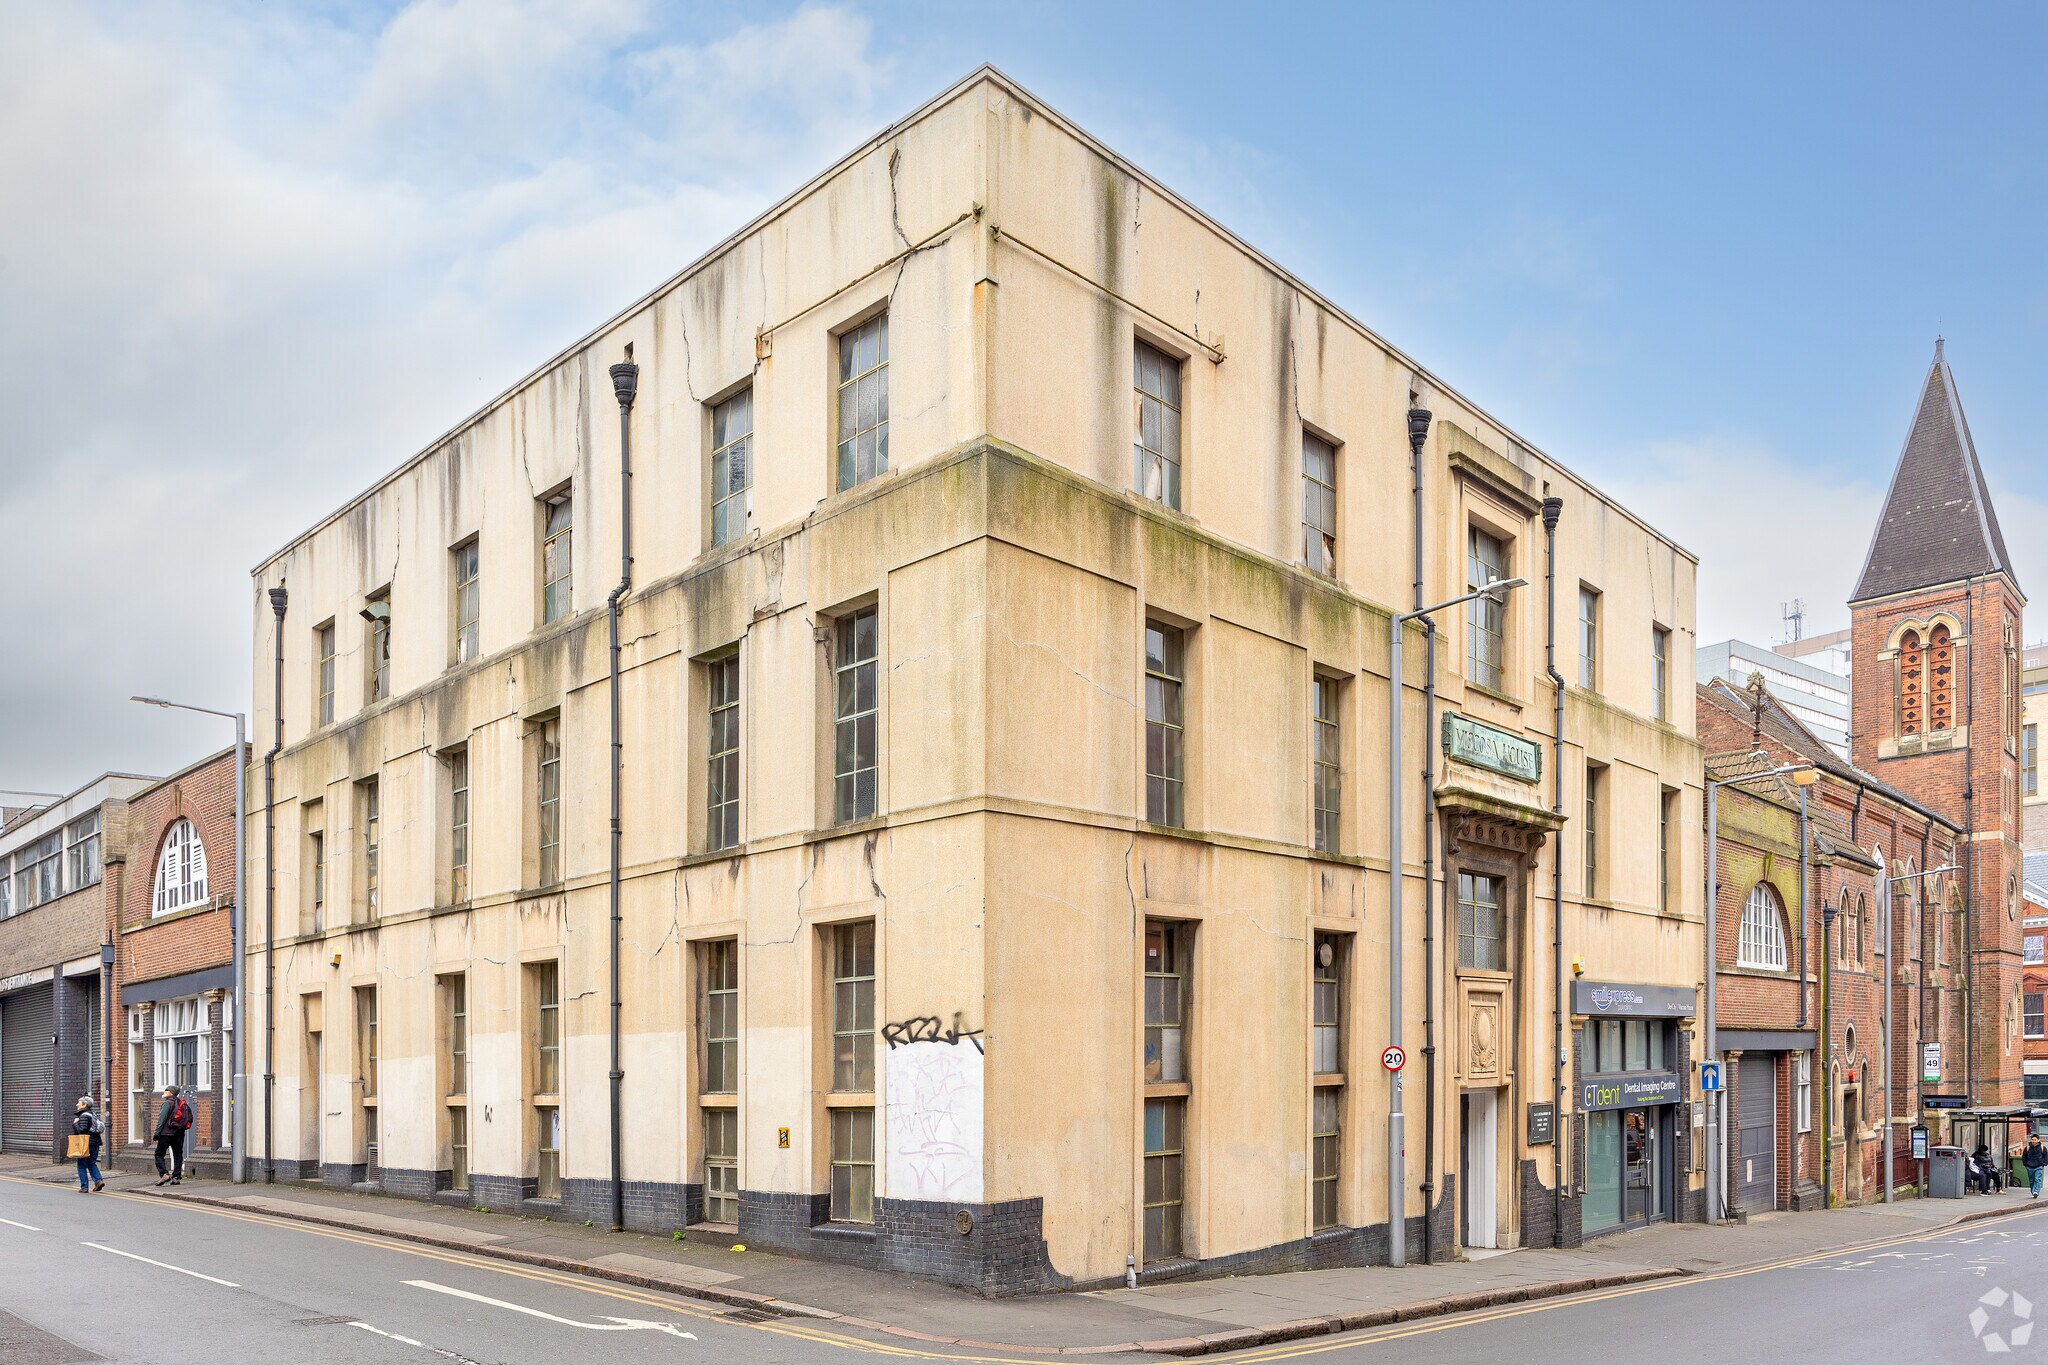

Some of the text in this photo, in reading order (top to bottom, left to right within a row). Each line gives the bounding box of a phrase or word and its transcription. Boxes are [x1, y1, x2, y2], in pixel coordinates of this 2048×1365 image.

[1456, 728, 1533, 769] VISCOSA HOUSE
[1385, 1053, 1402, 1065] 20
[1927, 1059, 1938, 1067] 49
[1624, 1082, 1640, 1093] Dental
[1641, 1080, 1660, 1094] Imaging
[1660, 1080, 1676, 1091] Centre
